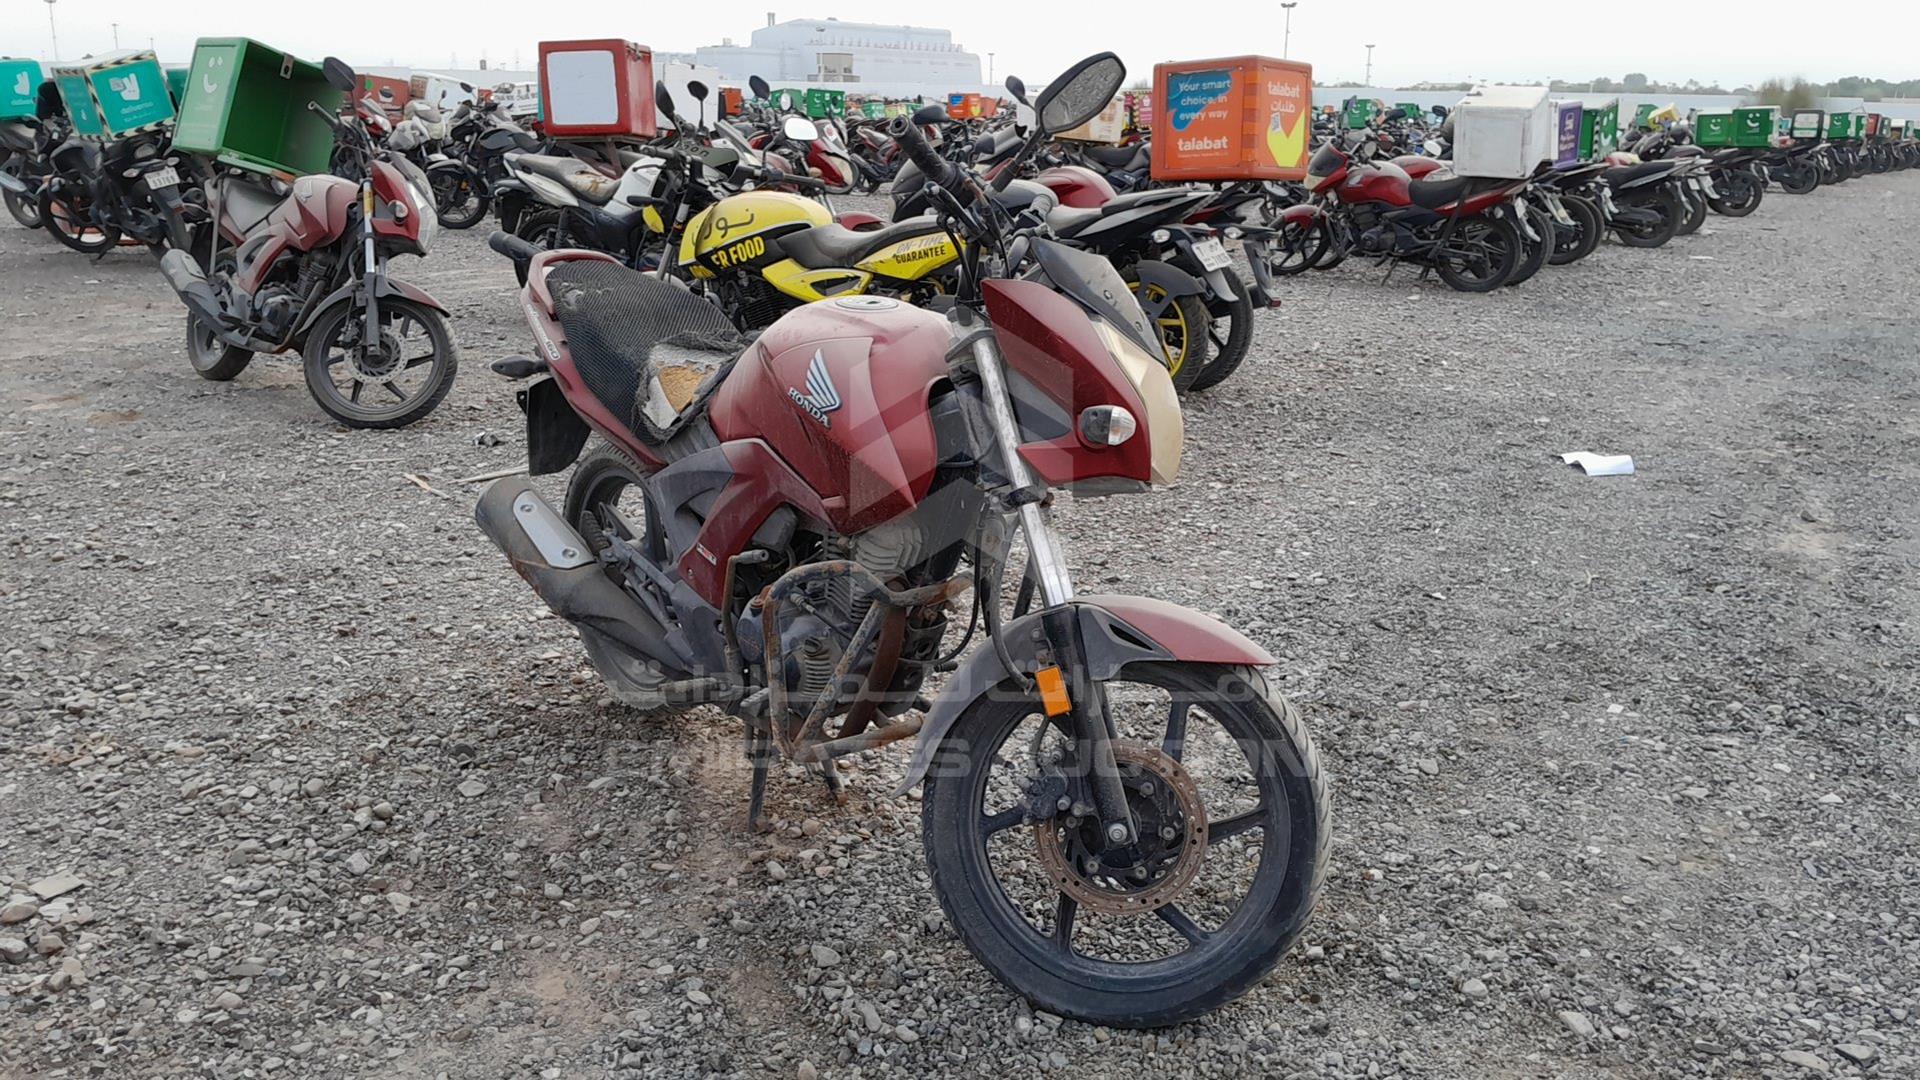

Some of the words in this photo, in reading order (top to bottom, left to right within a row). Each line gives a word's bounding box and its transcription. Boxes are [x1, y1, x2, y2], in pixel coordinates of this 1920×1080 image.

[1179, 81, 1200, 92] Your
[1268, 81, 1300, 98] talabat
[1177, 136, 1228, 151] talabat
[729, 236, 765, 264] FOOD
[895, 245, 947, 265] GUARANTEE
[788, 386, 831, 430] HONDA
